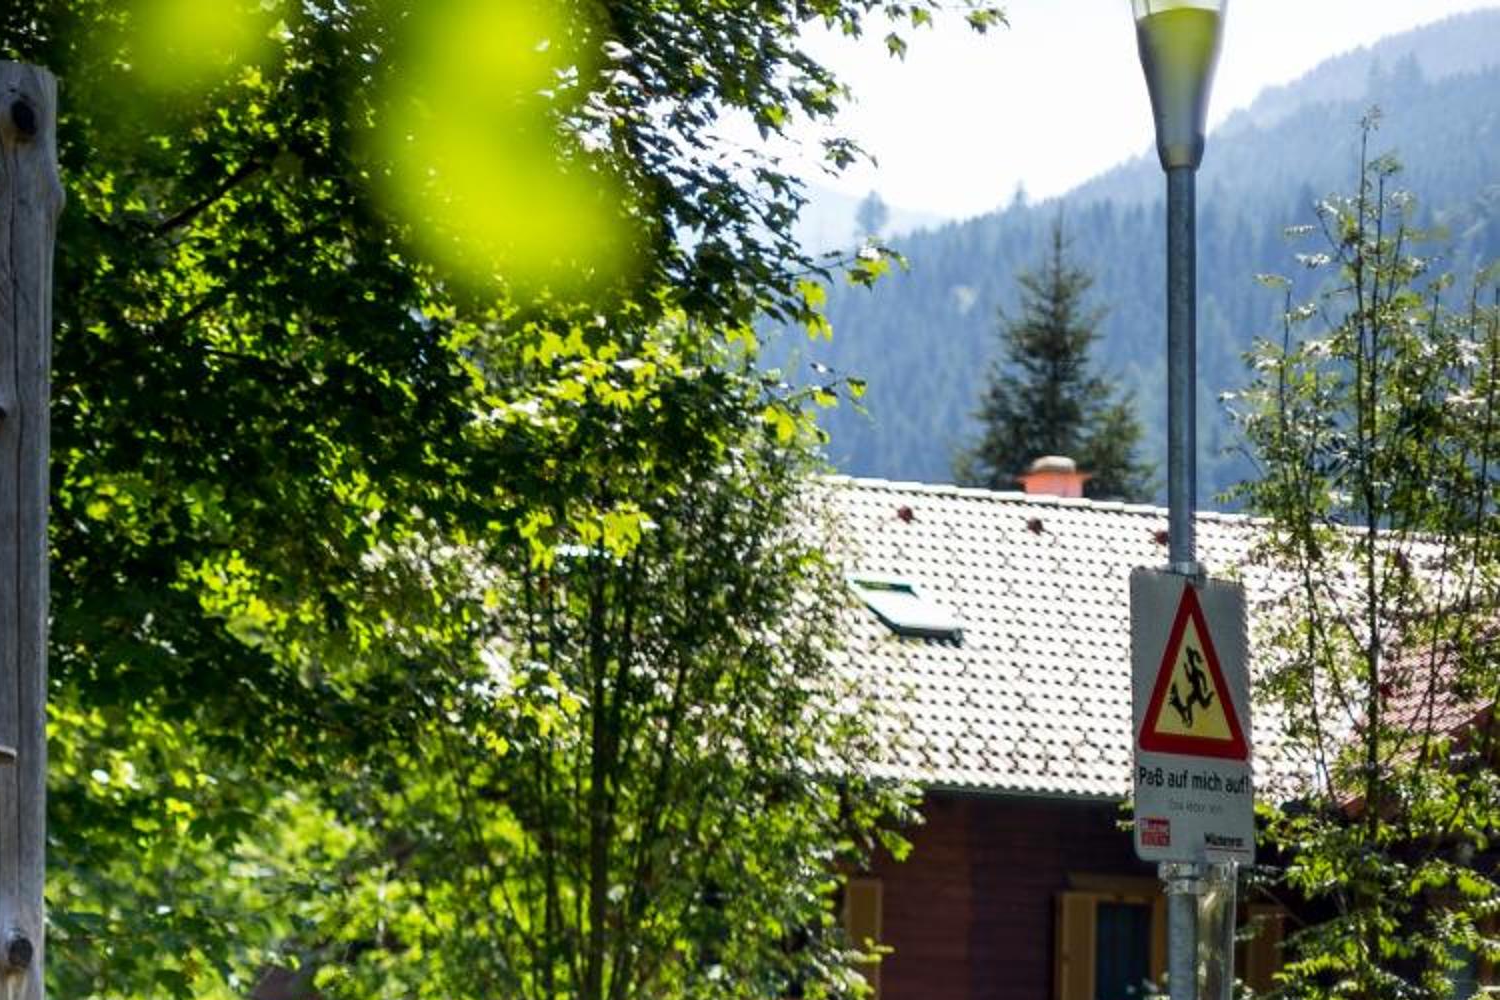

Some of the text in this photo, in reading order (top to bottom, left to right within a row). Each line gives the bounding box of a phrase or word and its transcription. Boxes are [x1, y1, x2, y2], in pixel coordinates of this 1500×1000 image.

[1139, 766, 1164, 787] Paß
[1168, 770, 1189, 789] auf
[1191, 771, 1222, 792] mich
